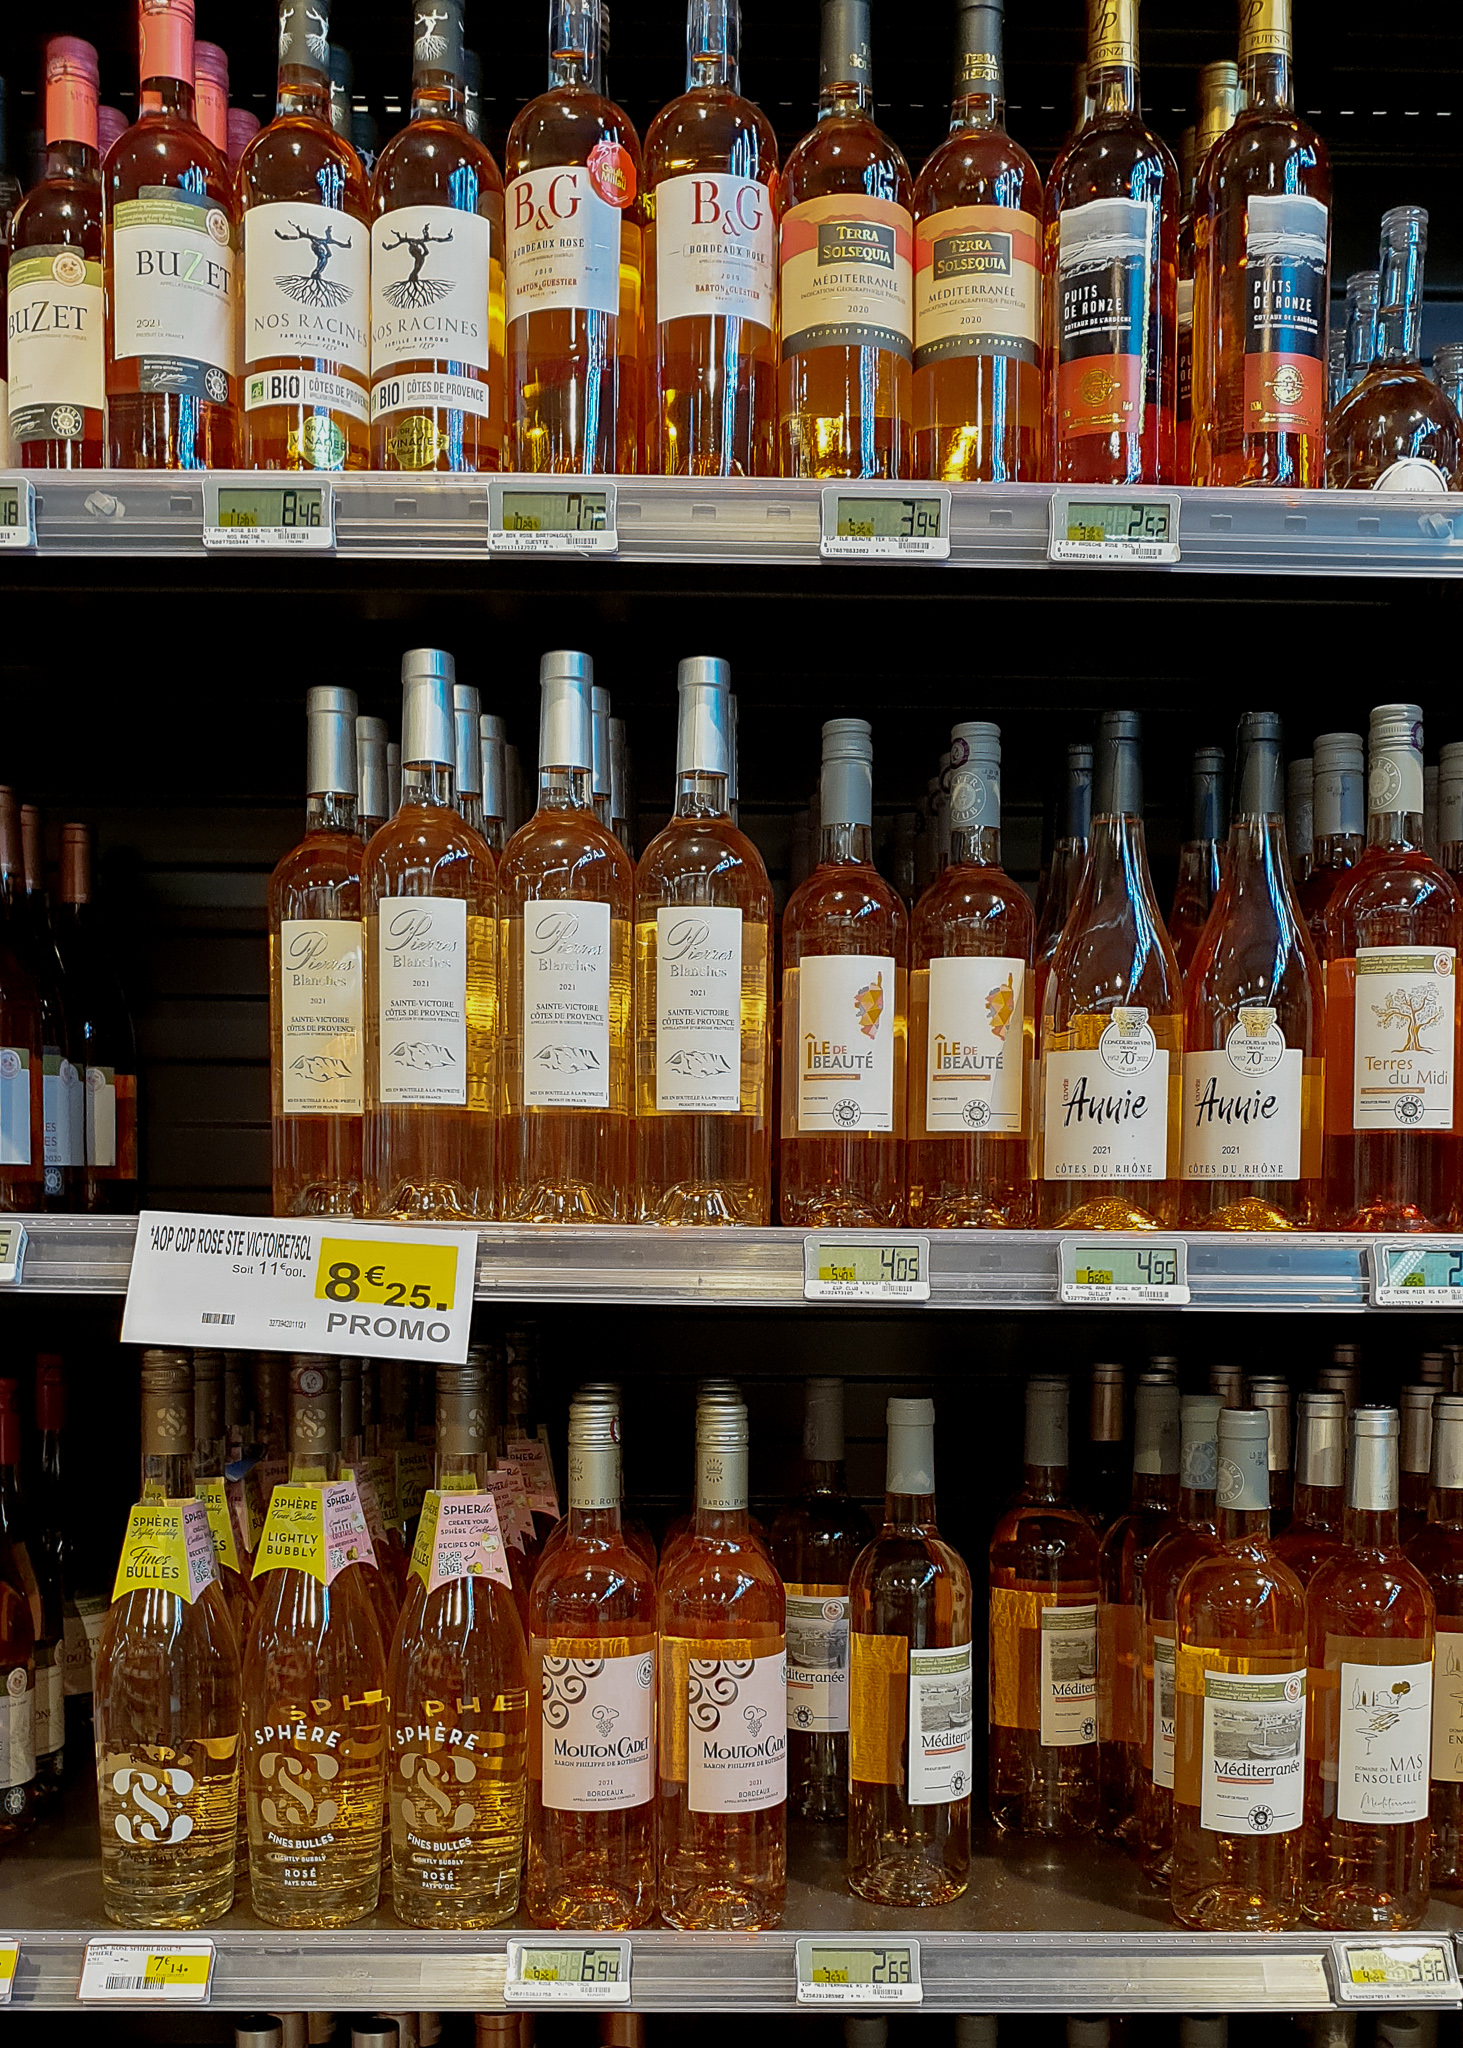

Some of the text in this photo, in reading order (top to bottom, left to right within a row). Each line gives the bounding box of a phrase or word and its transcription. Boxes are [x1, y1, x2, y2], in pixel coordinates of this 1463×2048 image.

[514, 174, 582, 232] B&G
[691, 180, 763, 237] B&G
[836, 226, 879, 242] TERRA
[514, 239, 554, 259] BORDEAUX
[560, 238, 584, 248] ROSÉ
[689, 245, 742, 256] BORDEAUX
[950, 240, 993, 252] TERRA
[823, 246, 891, 264] SOLSEQUIA
[136, 249, 231, 295] BUZET
[937, 257, 1007, 273] SOLSEQUIA
[812, 273, 898, 292] MÉDITERRANÉE
[1254, 280, 1291, 293] PUITS
[928, 285, 1015, 304] MÉDITERRANÉE
[1064, 285, 1098, 304] PUITS
[847, 305, 869, 314] 2020
[1064, 298, 1122, 319] DE RONZE
[1254, 297, 1312, 312] DE RONZE
[9, 301, 87, 339] BUZET
[398, 316, 478, 338] RACINES
[960, 316, 981, 324] 2020
[254, 313, 368, 347] NOS RACINES
[271, 376, 300, 399] BIO
[309, 378, 344, 395] CÔTES DE
[407, 379, 431, 393] CÔTES
[433, 382, 444, 392] DE
[446, 384, 484, 402] PROVENCE
[379, 382, 400, 409] BIO
[559, 983, 576, 991] 2021
[690, 989, 706, 997] 2021
[391, 1000, 454, 1008] SAINTE-VICTOIRE
[536, 1003, 598, 1012] SAINTE-VICTOIRE
[385, 1008, 407, 1017] CÔTES
[420, 1009, 460, 1018] PROVENCE
[530, 1011, 604, 1022] CÔTES DE PROVENCE
[667, 1009, 729, 1017] SAINTE-VICTOIRE
[662, 1017, 735, 1026] CÔTES DE PROVENCE
[833, 1046, 847, 1054] DE
[963, 1047, 978, 1055] DE
[813, 1051, 873, 1068] BEAUTÉ
[943, 1052, 1003, 1069] BEAUTÉ
[1365, 1056, 1413, 1070] Terres
[1389, 1070, 1448, 1084] du Midi
[1062, 1077, 1148, 1127] Annie
[1194, 1077, 1279, 1127] Annie
[1093, 1146, 1111, 1154] 2021
[1222, 1146, 1240, 1154] 2021
[1055, 1163, 1152, 1174] CÔTES DU RHÔNE
[1189, 1163, 1283, 1174] CÔTES DU RHÔNE
[175, 1227, 196, 1252] CDP
[197, 1229, 225, 1254] ROSE
[226, 1230, 245, 1256] STE
[232, 1265, 253, 1274] Soit
[327, 1312, 450, 1343] PROMO
[274, 1497, 318, 1510] SPHÈRE
[443, 1503, 492, 1515] SPHERito
[133, 1514, 178, 1527] SPHÈRE
[268, 1532, 319, 1544] LIGHTLY
[441, 1527, 466, 1535] SPHÈRE
[130, 1546, 171, 1567] Fines
[267, 1545, 317, 1557] BUBBLY
[126, 1567, 179, 1578] BULLES
[255, 1718, 341, 1748] SPHÈRE
[396, 1721, 480, 1751] SPHÈRE
[554, 1759, 574, 1767] BARON
[1213, 1759, 1300, 1777] Méditerranée
[1390, 1754, 1422, 1771] MAS
[738, 1788, 770, 1798] BORDEAUX
[267, 1831, 335, 1850] FINES BULLES
[407, 1833, 472, 1852] FINES BULLES
[284, 1866, 317, 1878] ROSÉ
[422, 1870, 454, 1881] ROSÉ
